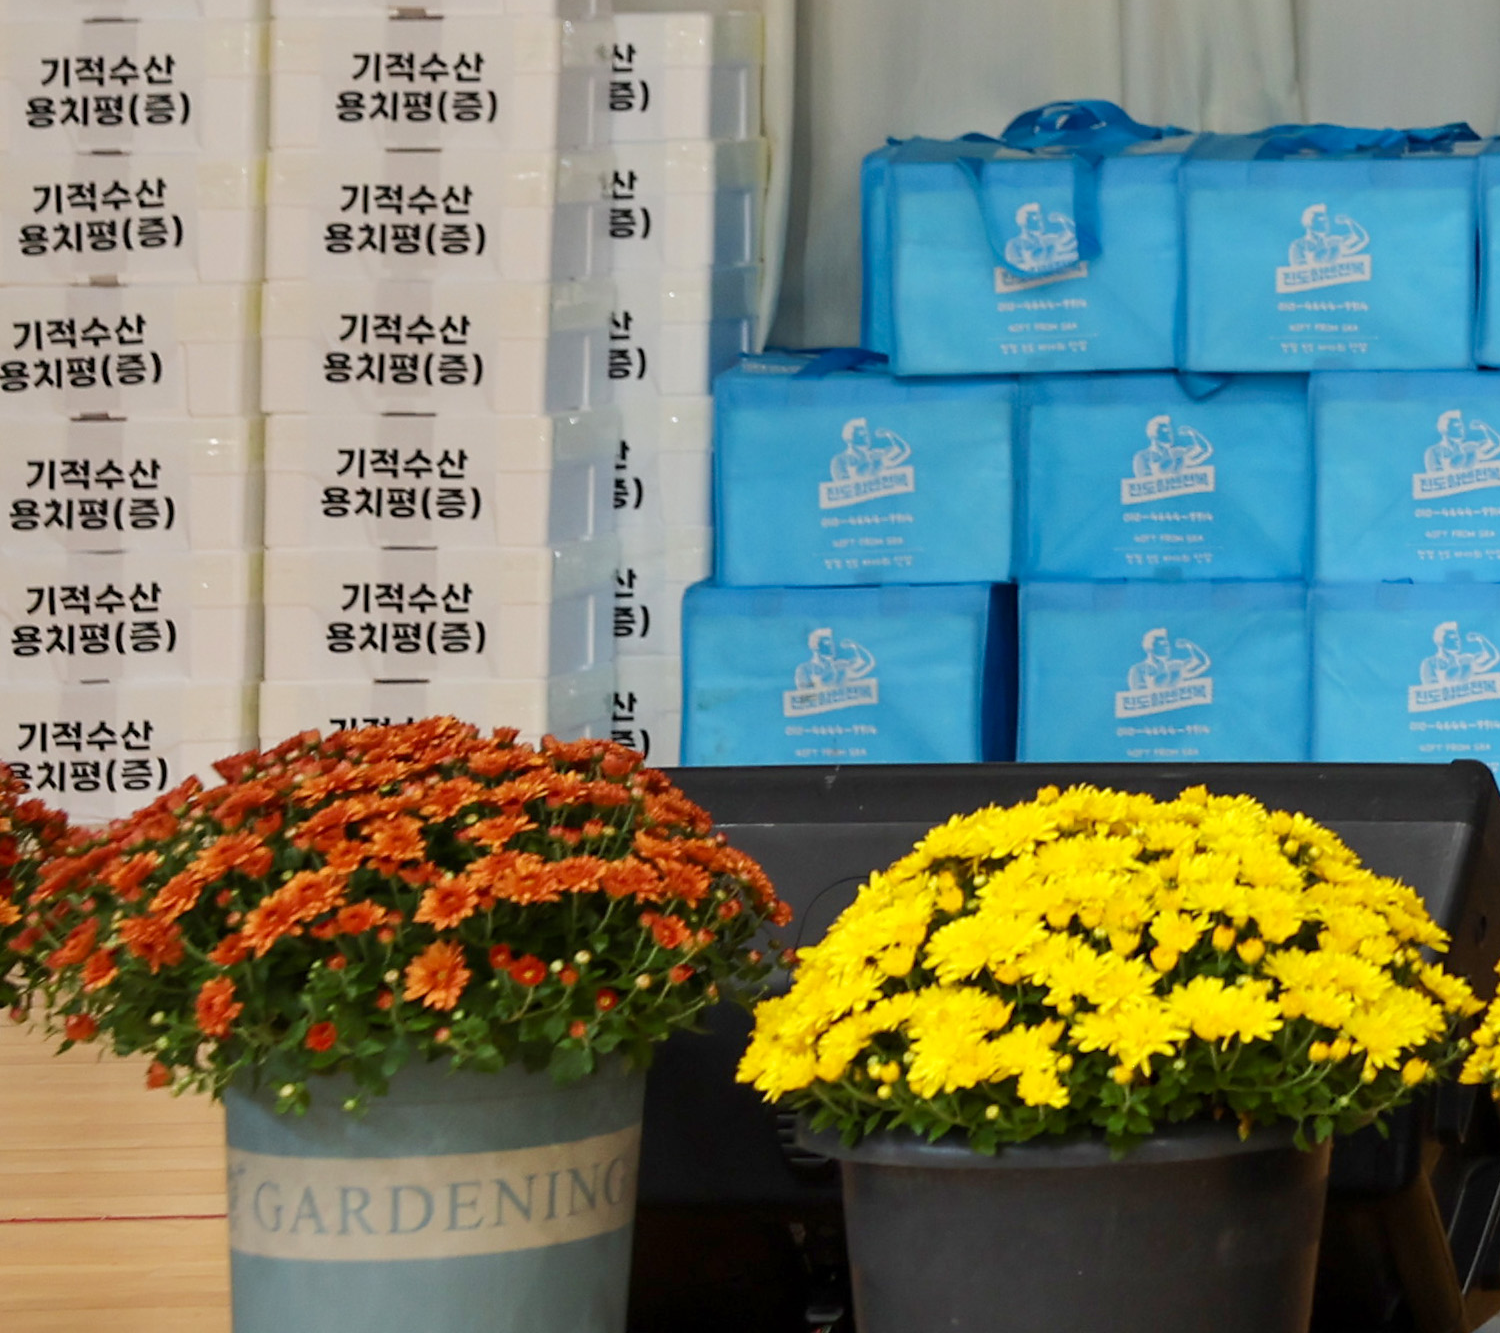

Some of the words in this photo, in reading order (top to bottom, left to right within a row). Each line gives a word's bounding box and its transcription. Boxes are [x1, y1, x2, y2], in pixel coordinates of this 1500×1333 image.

[42, 55, 175, 88] 기적수산
[353, 53, 484, 82] 기적수산
[26, 92, 190, 128] 용치평(증)
[336, 91, 497, 123] 용치평(증)
[34, 178, 166, 214] 기적수산
[341, 185, 472, 215] 기적수산
[19, 215, 183, 256] 용치평(증)
[325, 223, 485, 255] 용치평(증)
[13, 314, 145, 351] 기적수산
[340, 314, 470, 345] 기적수산
[0, 352, 161, 392] 용치평(증)
[324, 353, 482, 385] 용치평(증)
[27, 459, 160, 490] 기적수산
[337, 449, 467, 479] 기적수산
[10, 497, 174, 530] 용치평(증)
[322, 487, 480, 519] 용치평(증)
[27, 583, 161, 616] 기적수산
[342, 583, 472, 613] 기적수산
[12, 620, 176, 656] 용치평(증)
[327, 621, 485, 654] 용치평(증)
[18, 721, 153, 752] 기적수산
[252, 1159, 631, 1235] GARDENING
